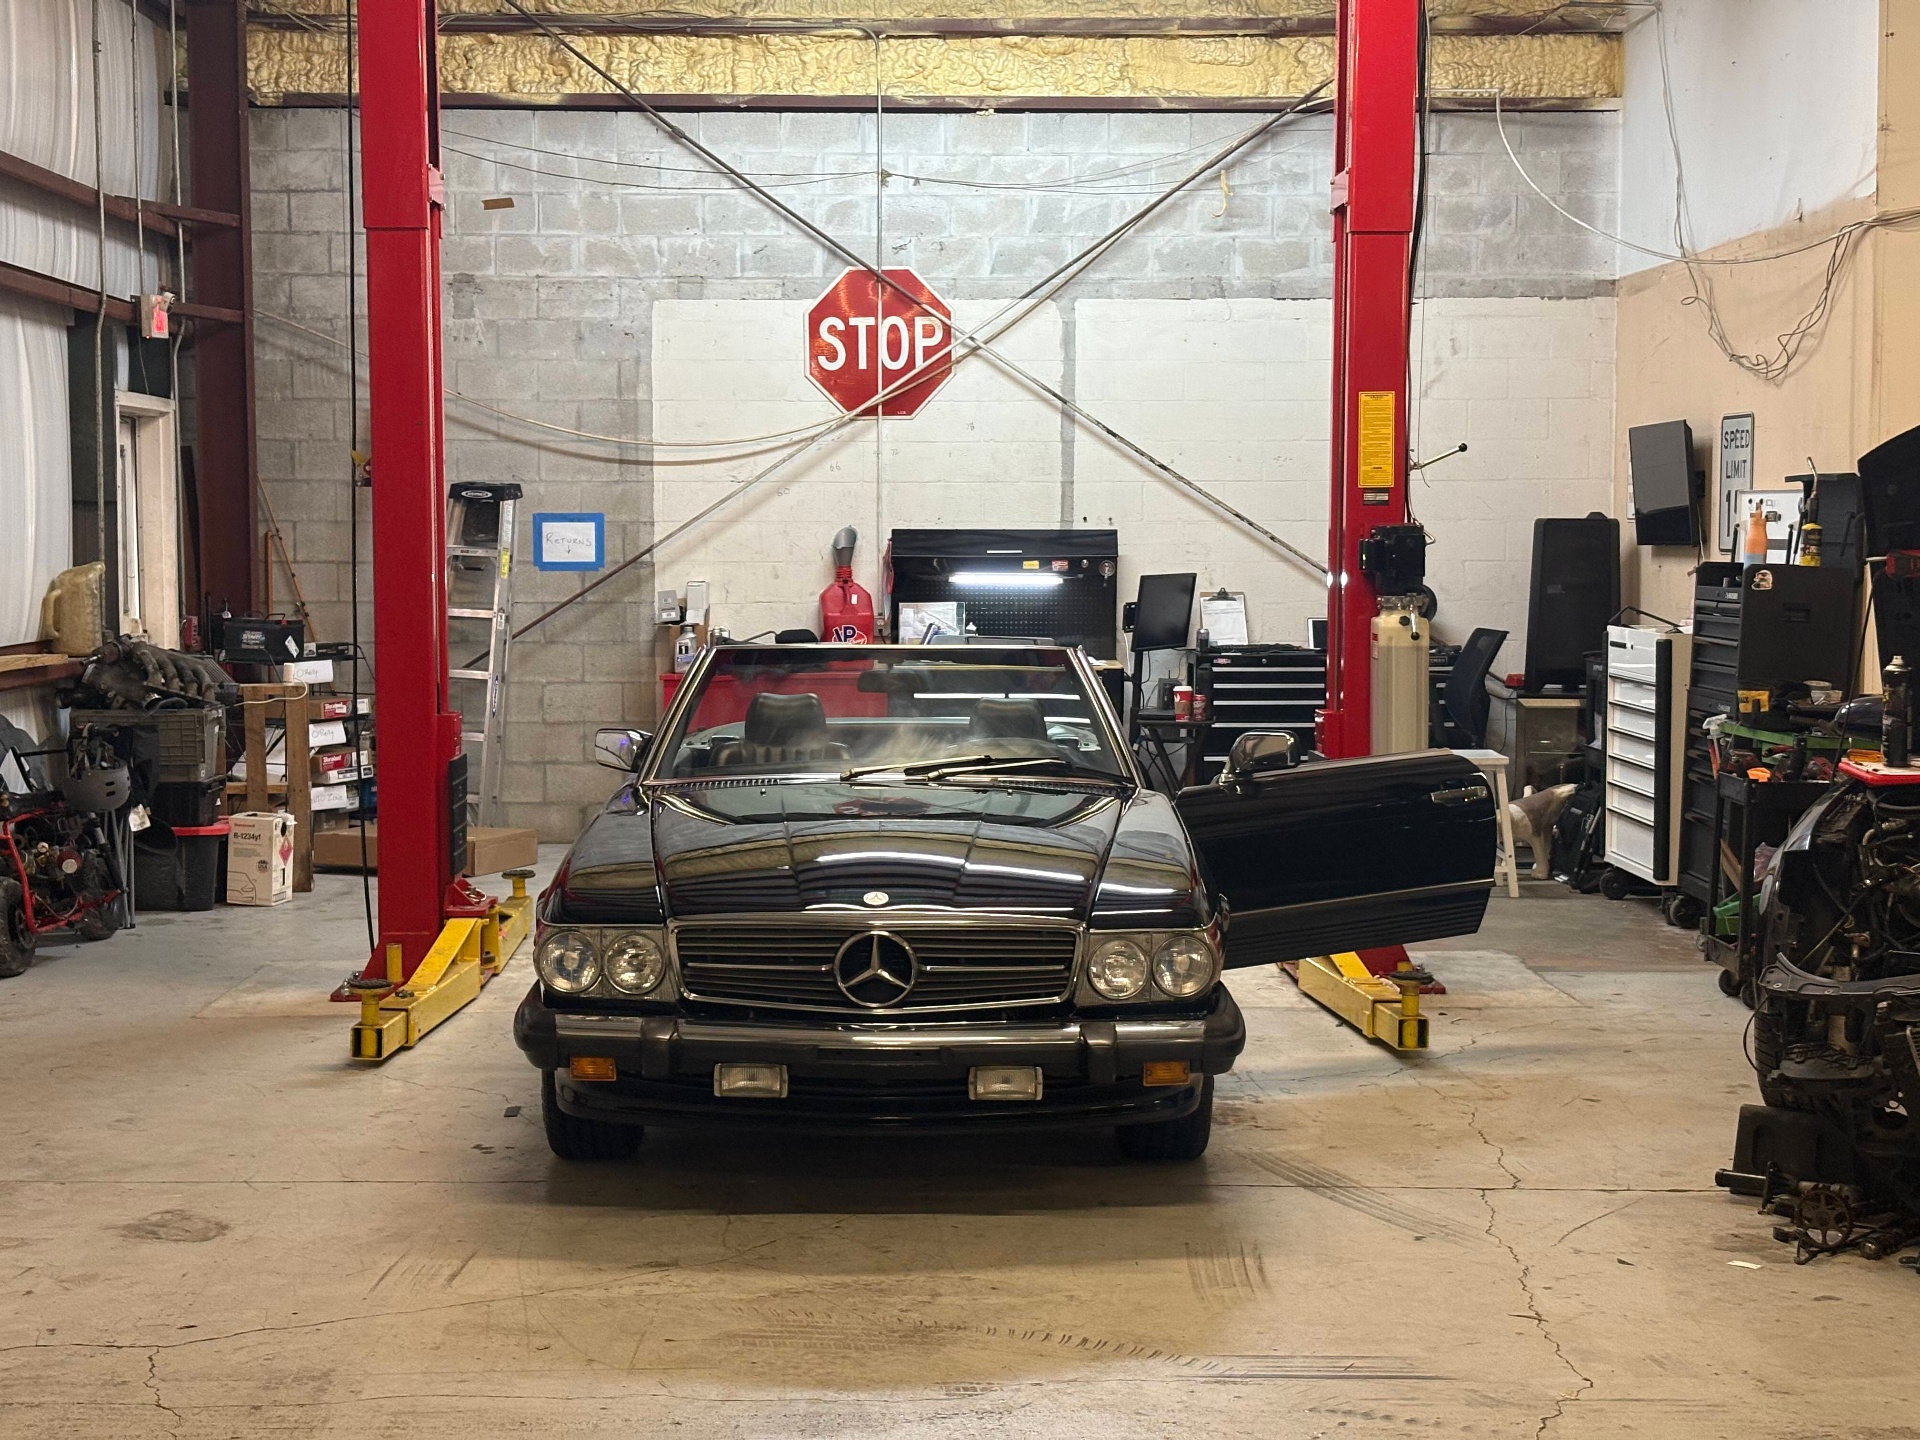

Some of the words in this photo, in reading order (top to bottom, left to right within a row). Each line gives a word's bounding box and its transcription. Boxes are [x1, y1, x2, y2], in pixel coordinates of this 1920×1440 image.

[817, 316, 944, 371] STOP
[1723, 429, 1750, 450] SPEED
[1725, 460, 1747, 479] LIMIT
[233, 832, 262, 842] R-1234yf
